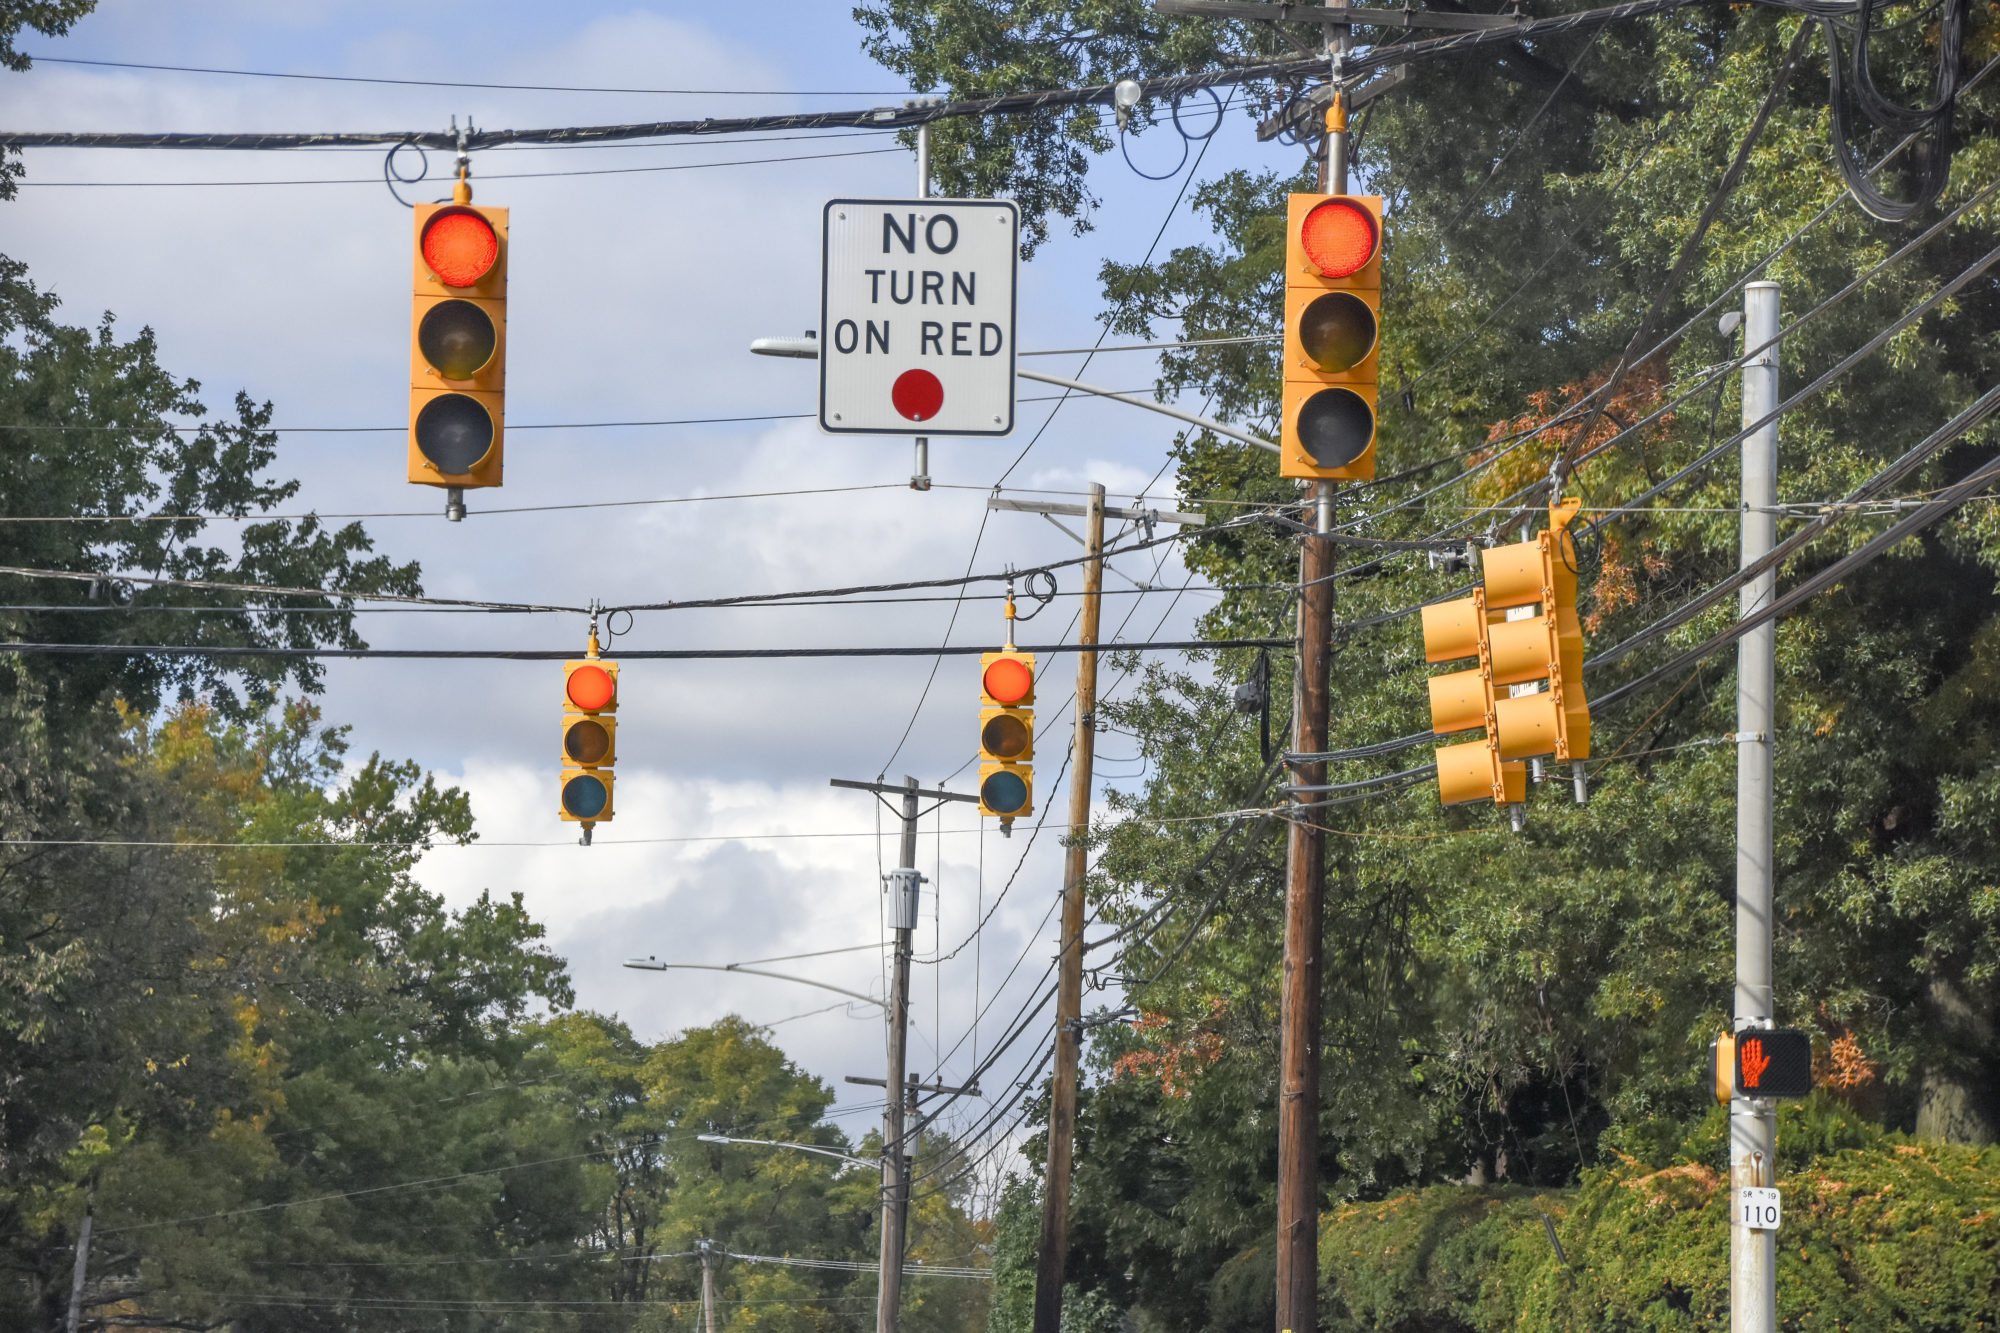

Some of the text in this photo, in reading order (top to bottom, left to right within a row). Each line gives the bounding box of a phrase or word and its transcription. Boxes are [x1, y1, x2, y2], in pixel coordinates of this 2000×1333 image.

[882, 213, 959, 255] NO
[864, 269, 976, 306] TURN
[834, 318, 1003, 357] ON RED
[1742, 1190, 1753, 1199] SR
[1744, 1205, 1777, 1224] 110
